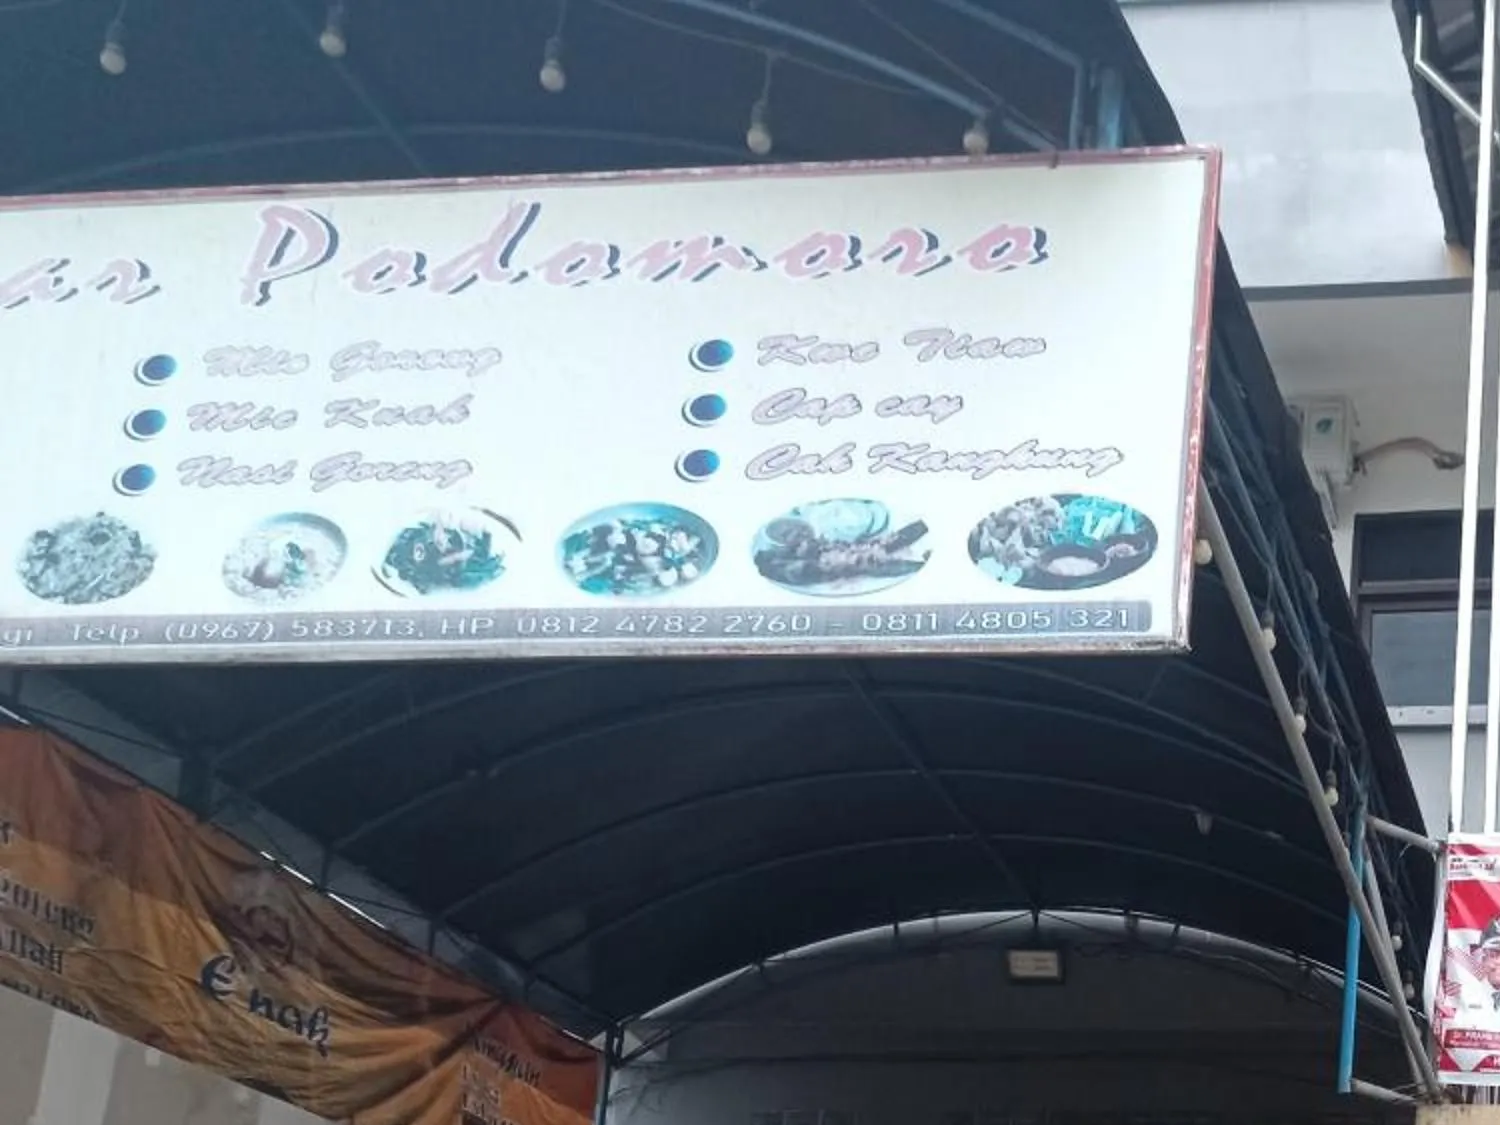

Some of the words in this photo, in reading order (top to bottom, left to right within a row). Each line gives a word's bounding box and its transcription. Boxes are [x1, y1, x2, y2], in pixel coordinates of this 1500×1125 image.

[240, 201, 1048, 306] Podomoro
[751, 387, 862, 425] Cap
[440, 616, 495, 636] HP
[516, 614, 600, 635] 0812
[615, 612, 708, 634] 4782
[723, 611, 812, 632] 2760
[862, 611, 939, 631] 0811
[954, 609, 1052, 630] 4805
[1069, 608, 1129, 628] 321
